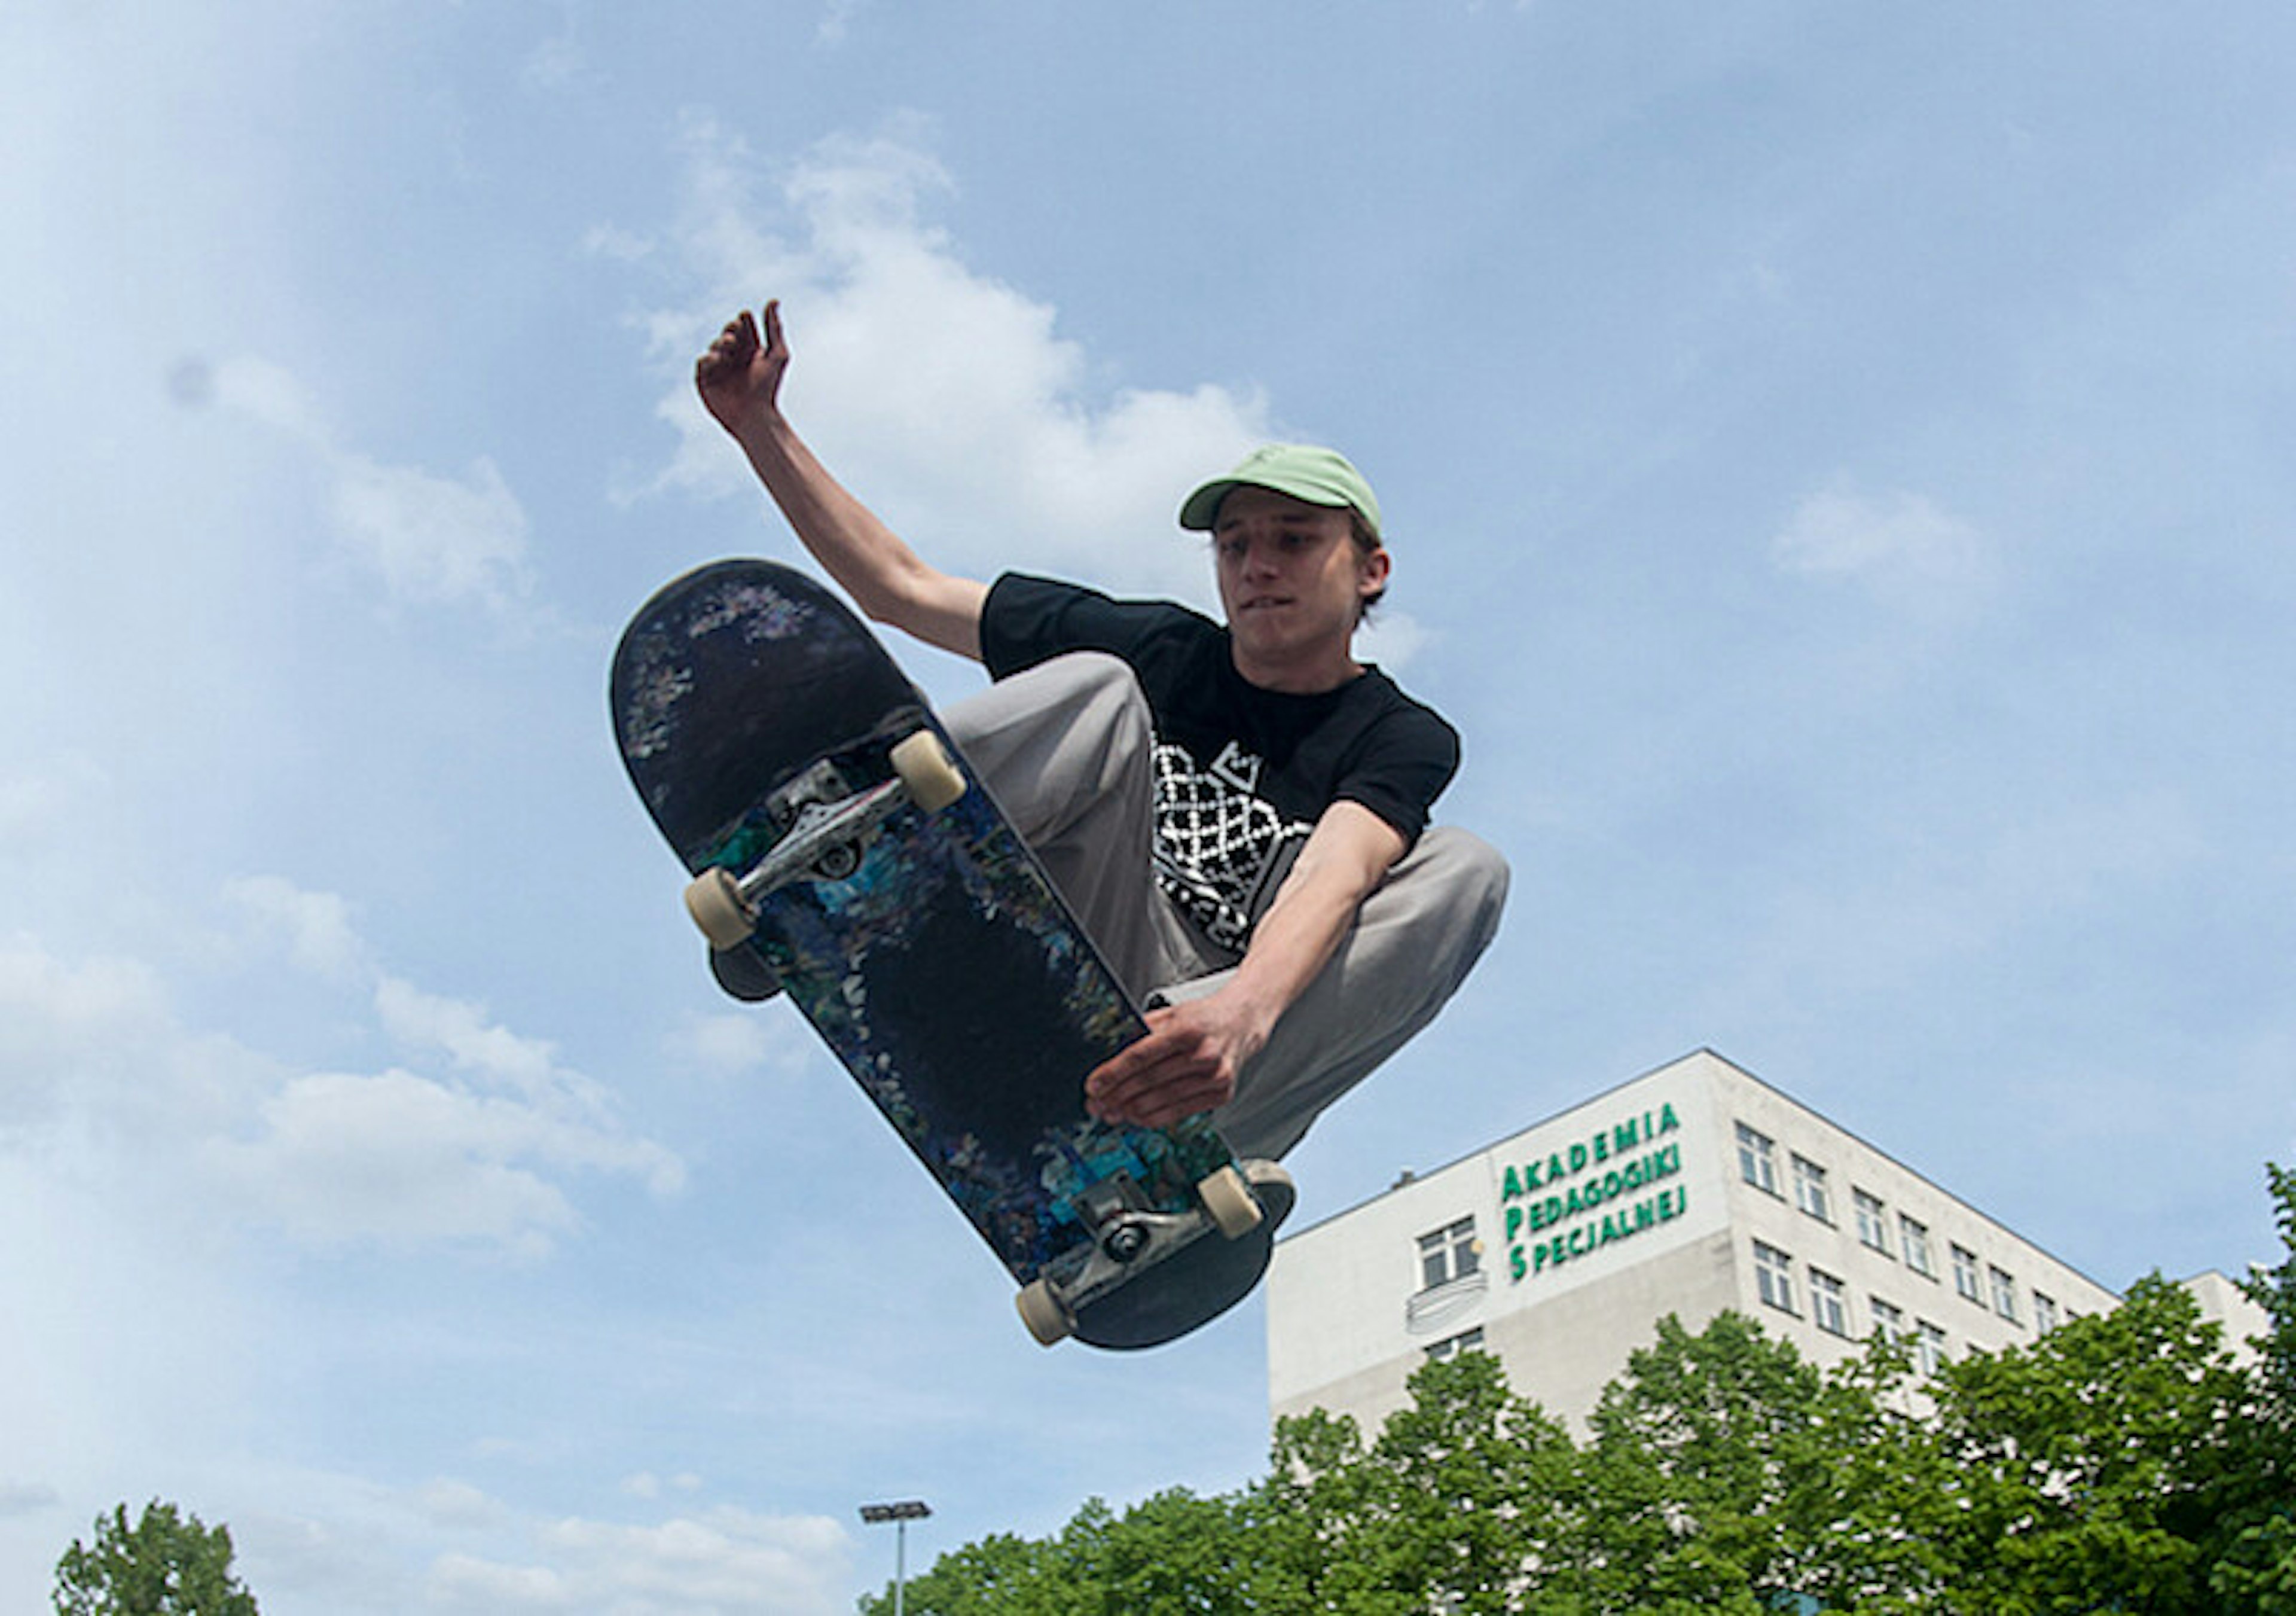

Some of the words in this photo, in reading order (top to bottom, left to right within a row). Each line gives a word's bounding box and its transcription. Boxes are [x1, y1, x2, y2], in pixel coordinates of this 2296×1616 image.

[1501, 1102, 1680, 1202] AKADEMIA
[1505, 1143, 1681, 1242] PEDAGOGIKI
[1509, 1185, 1687, 1280] SPECJALNEJ
